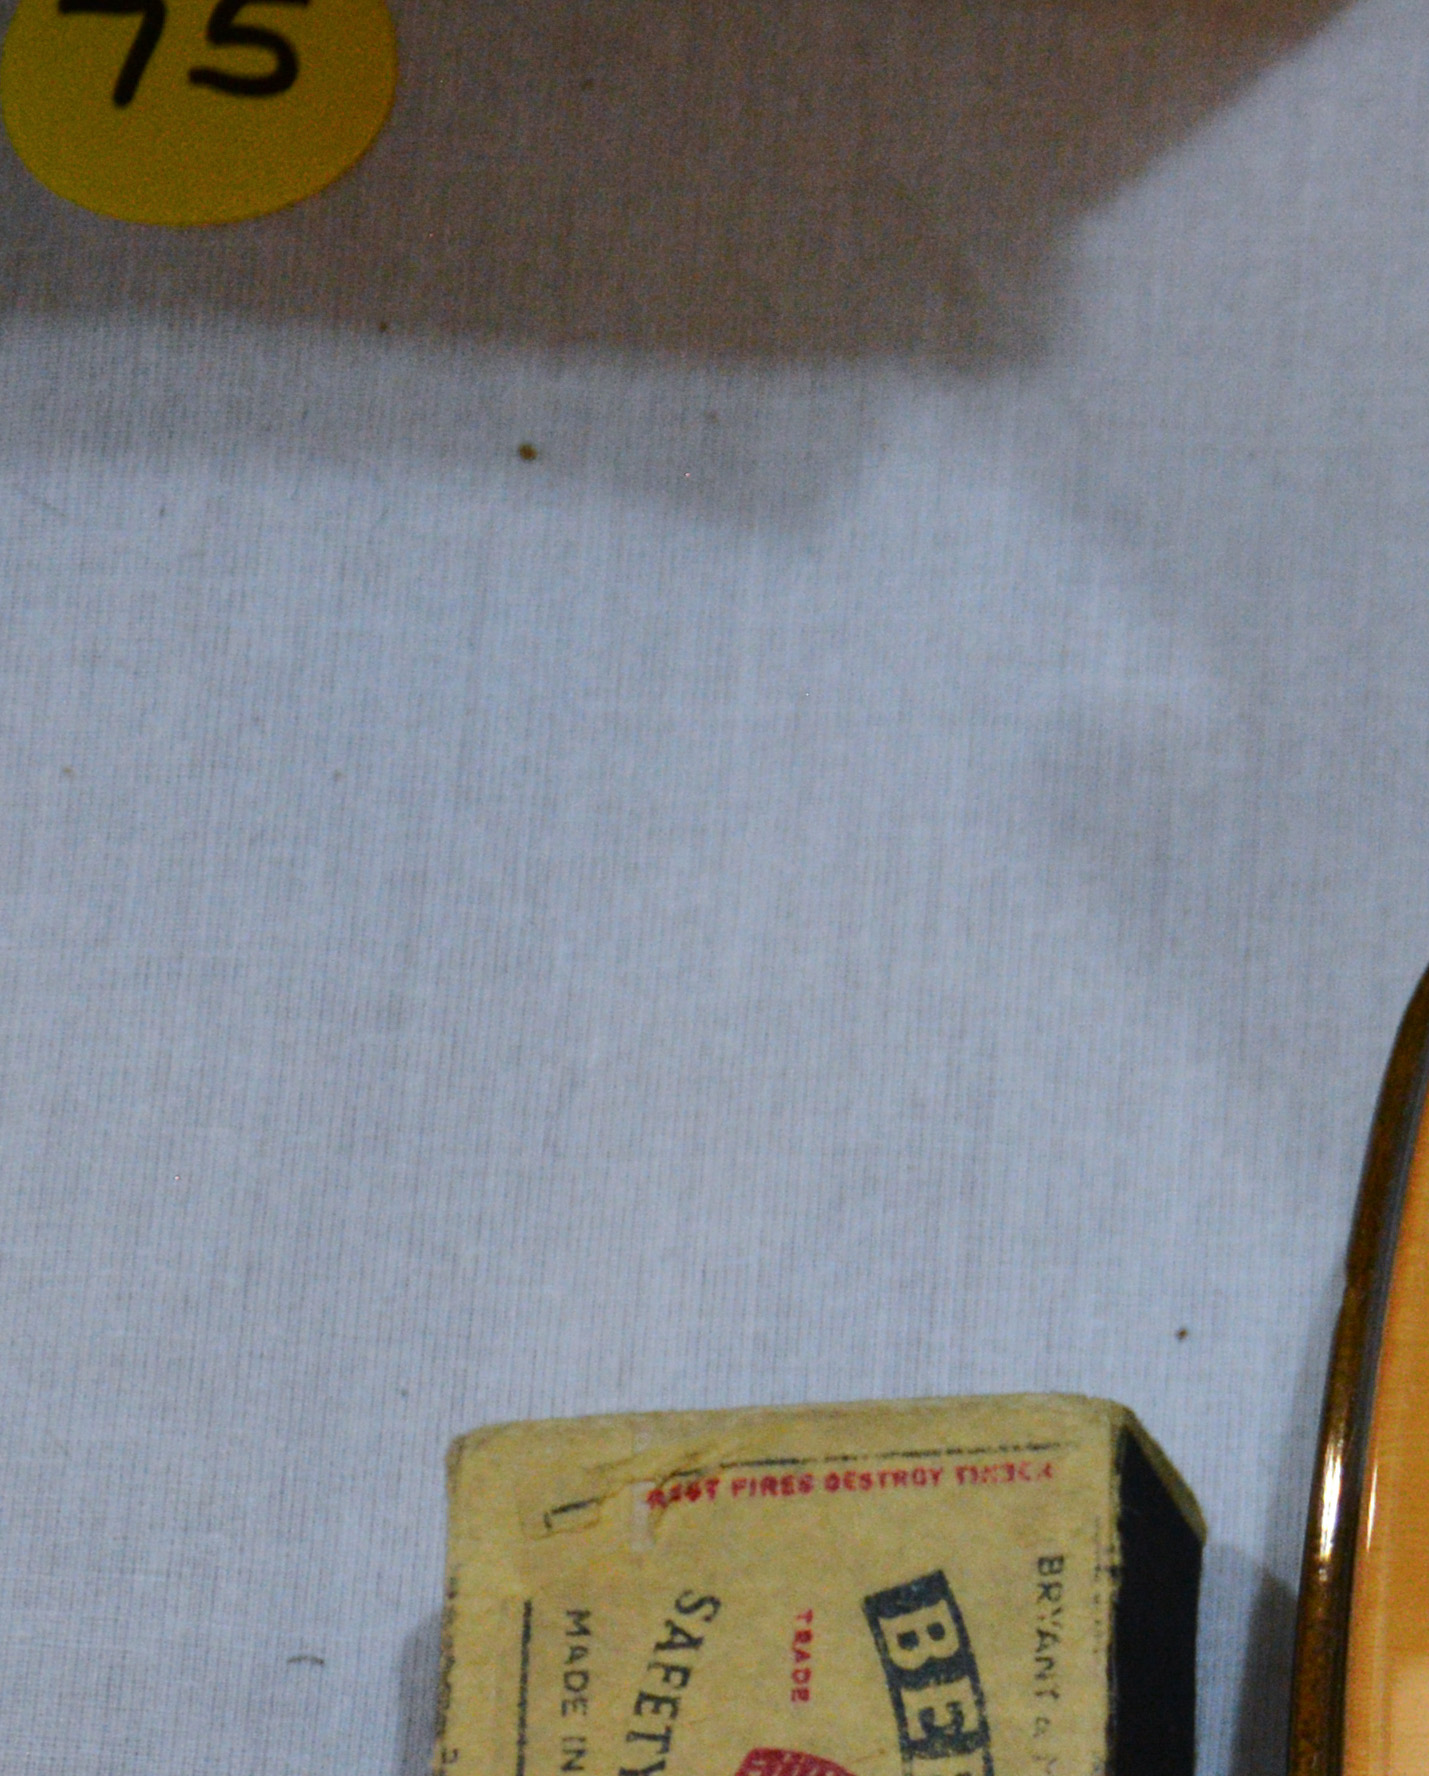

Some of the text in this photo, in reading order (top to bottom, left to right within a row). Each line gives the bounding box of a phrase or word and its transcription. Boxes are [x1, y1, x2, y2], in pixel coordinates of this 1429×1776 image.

[57, 0, 313, 107] 75
[561, 1609, 592, 1718] MADE
[790, 1608, 815, 1704] TRADE
[559, 1735, 588, 1772] IN
